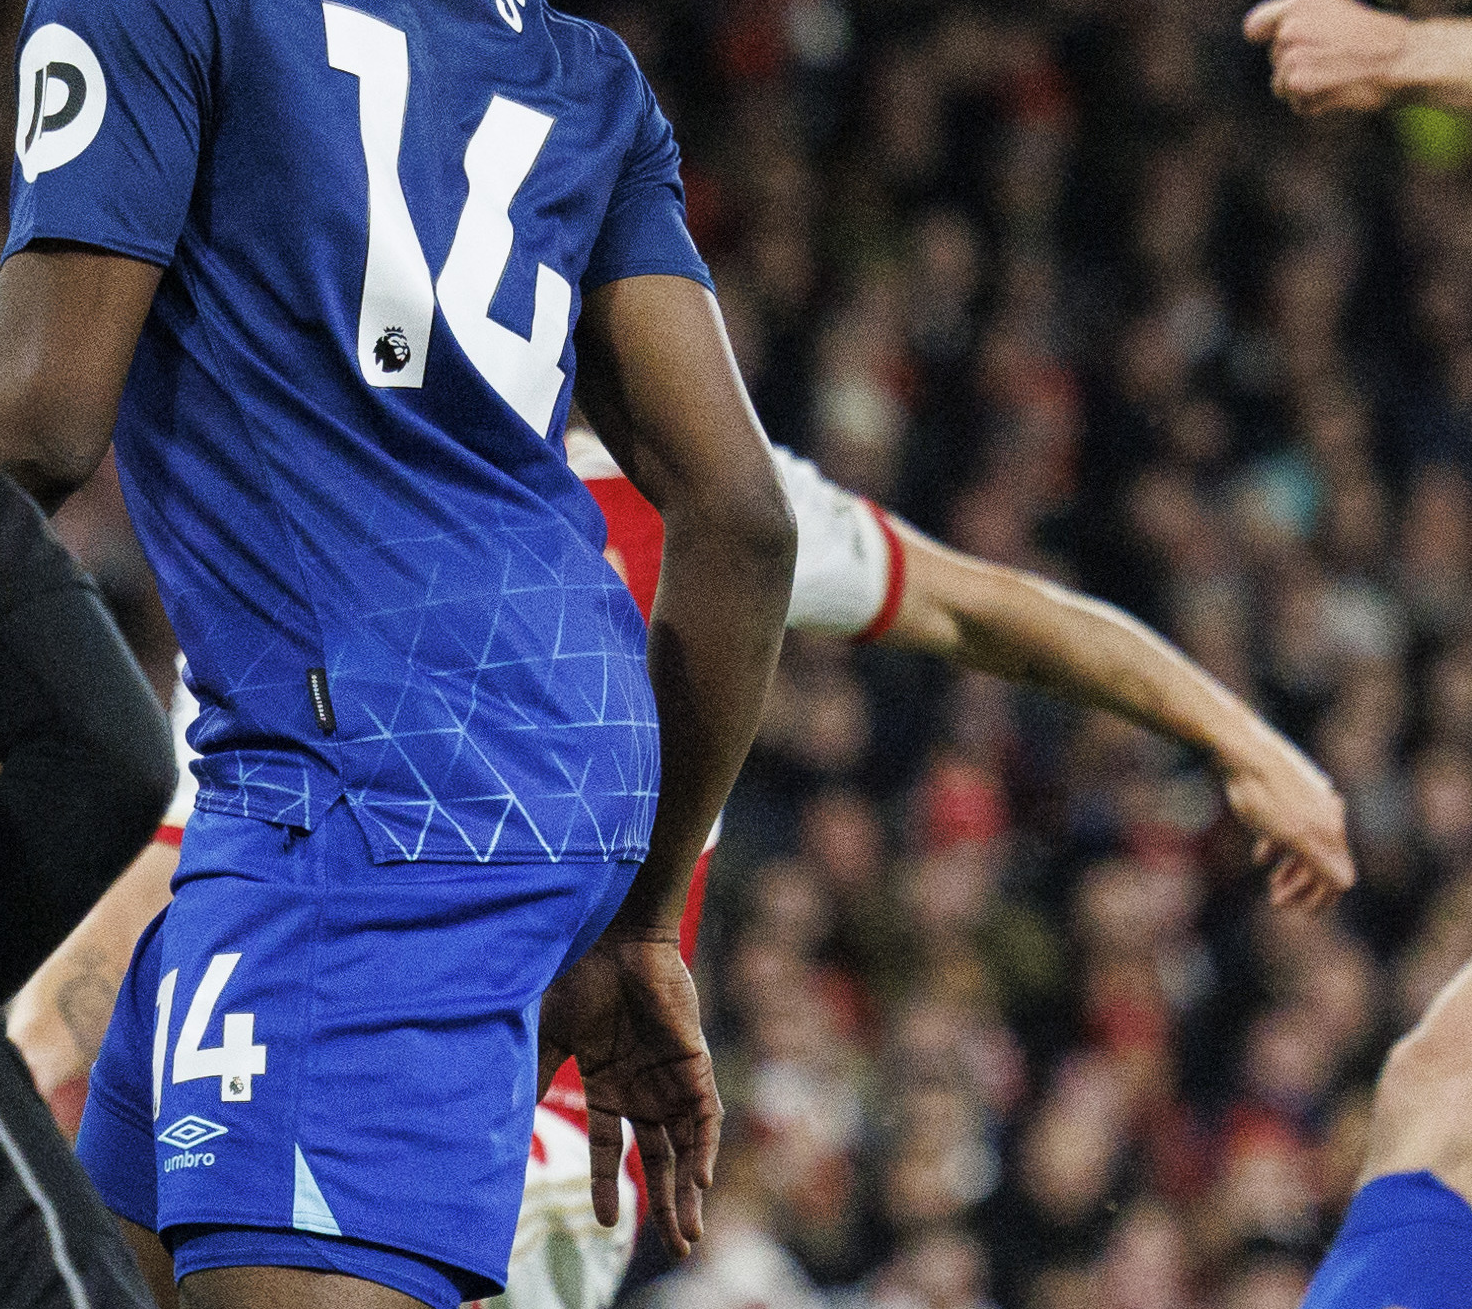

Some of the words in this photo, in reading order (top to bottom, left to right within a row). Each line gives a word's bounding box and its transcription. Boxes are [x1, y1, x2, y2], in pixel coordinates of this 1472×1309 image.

[321, 0, 573, 440] 14
[152, 952, 267, 1121] 14
[163, 1148, 216, 1173] umbro
